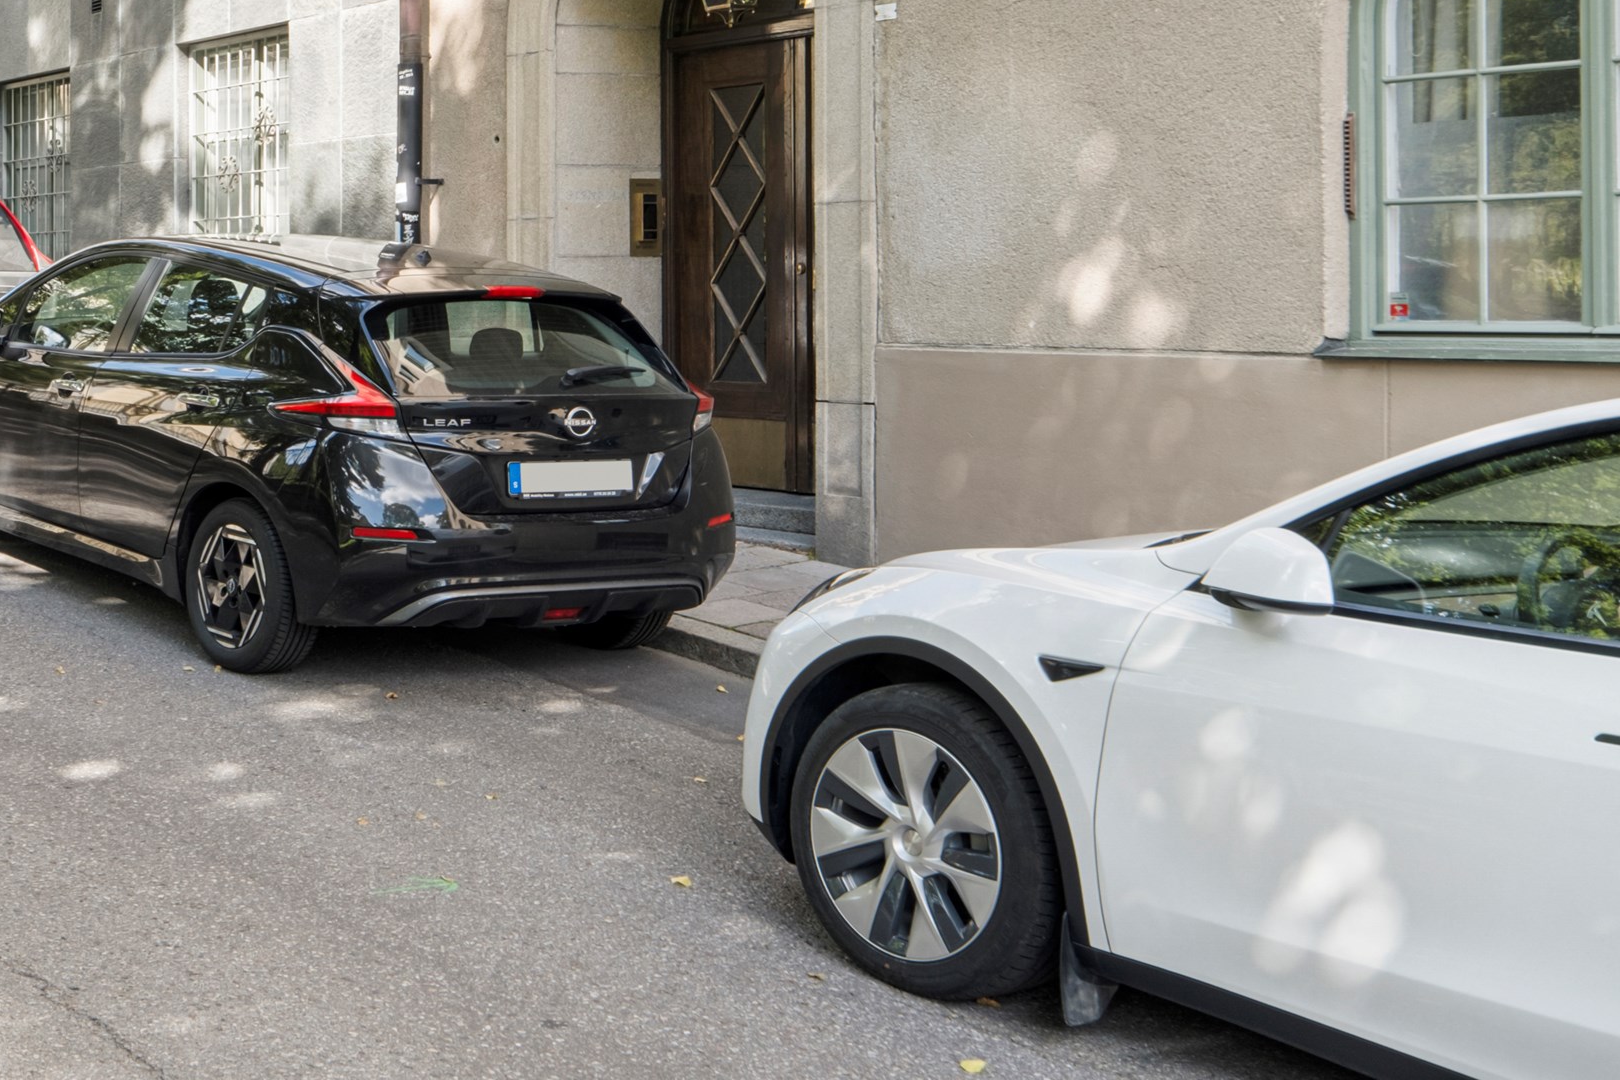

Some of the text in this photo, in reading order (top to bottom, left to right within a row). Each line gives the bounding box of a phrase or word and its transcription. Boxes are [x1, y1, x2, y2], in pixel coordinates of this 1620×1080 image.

[423, 418, 472, 427] LEAF
[564, 418, 597, 427] NISSAN
[513, 481, 518, 489] S
